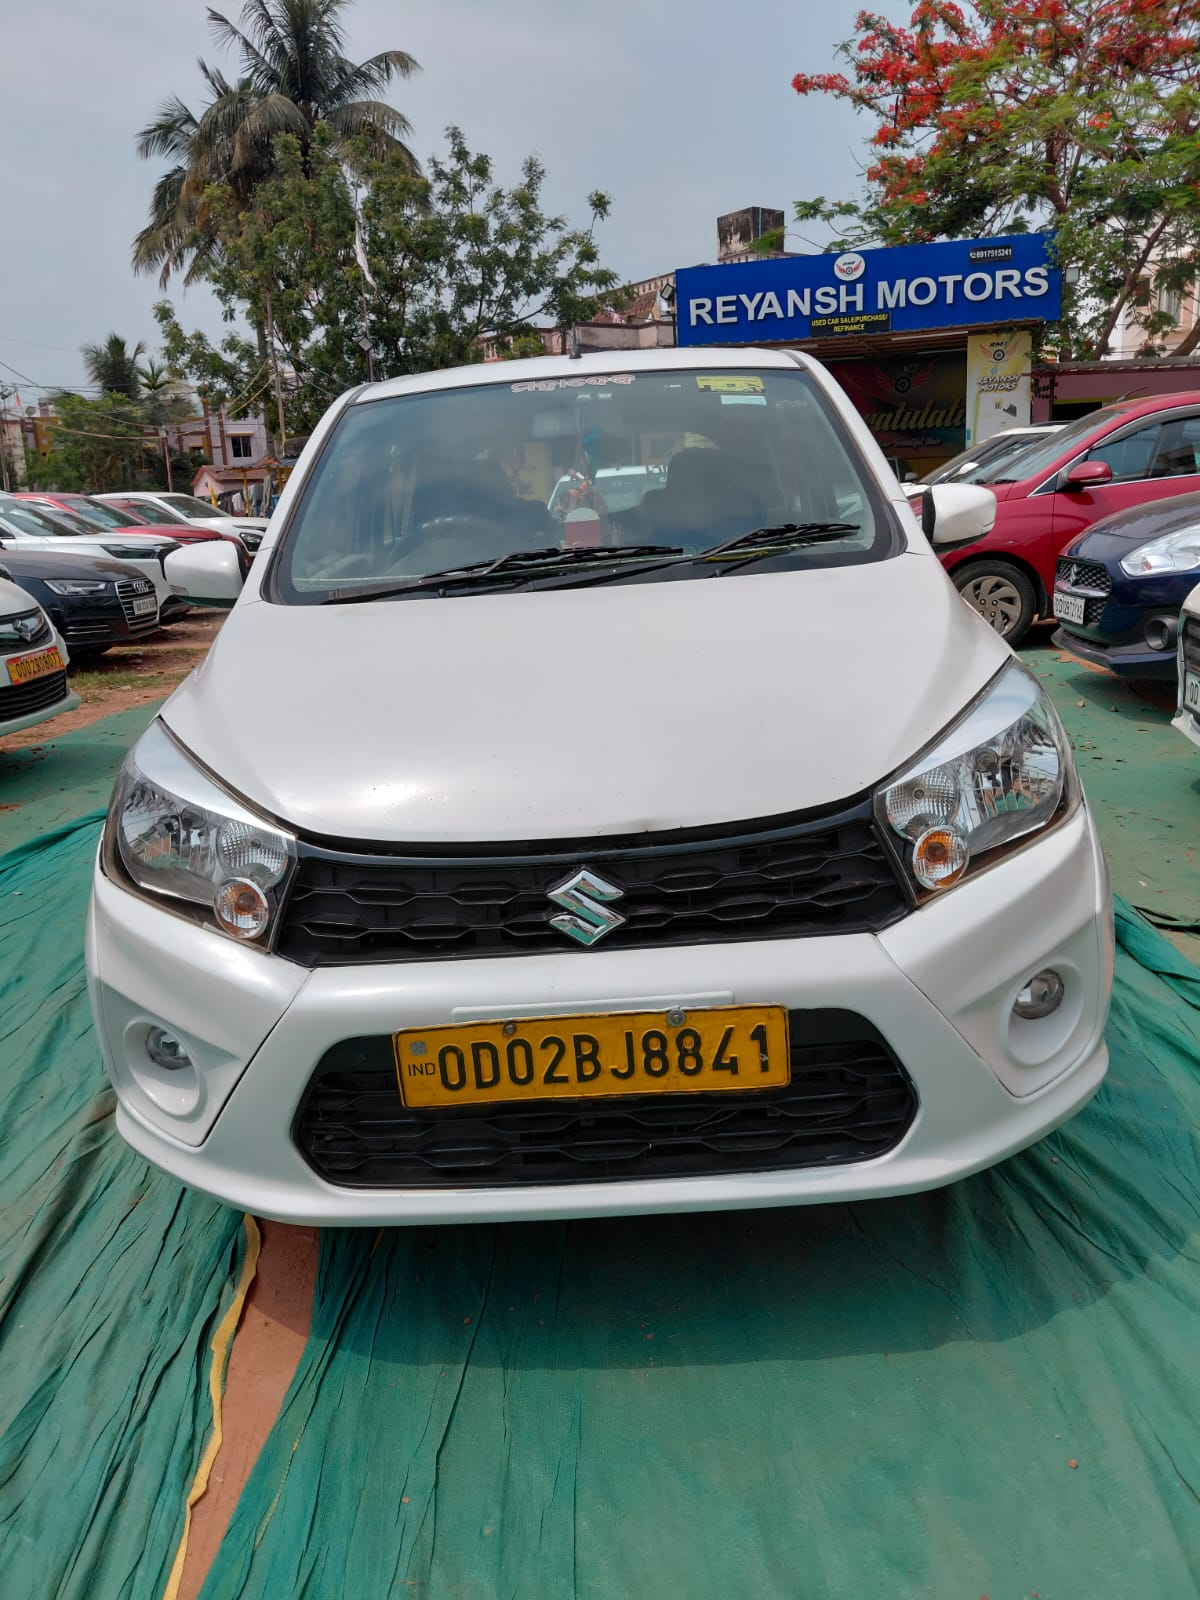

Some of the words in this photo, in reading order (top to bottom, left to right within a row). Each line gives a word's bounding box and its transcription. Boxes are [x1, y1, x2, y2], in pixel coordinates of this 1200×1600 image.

[689, 282, 865, 326] REYANSH
[877, 266, 1050, 310] MOTORS
[811, 319, 827, 327] USED
[833, 323, 865, 333] REFINANCE
[977, 374, 1020, 385] REYANSH
[979, 382, 1017, 393] MOTORS
[438, 1023, 770, 1092] OD02BJ8841
[407, 1062, 436, 1077] IND
